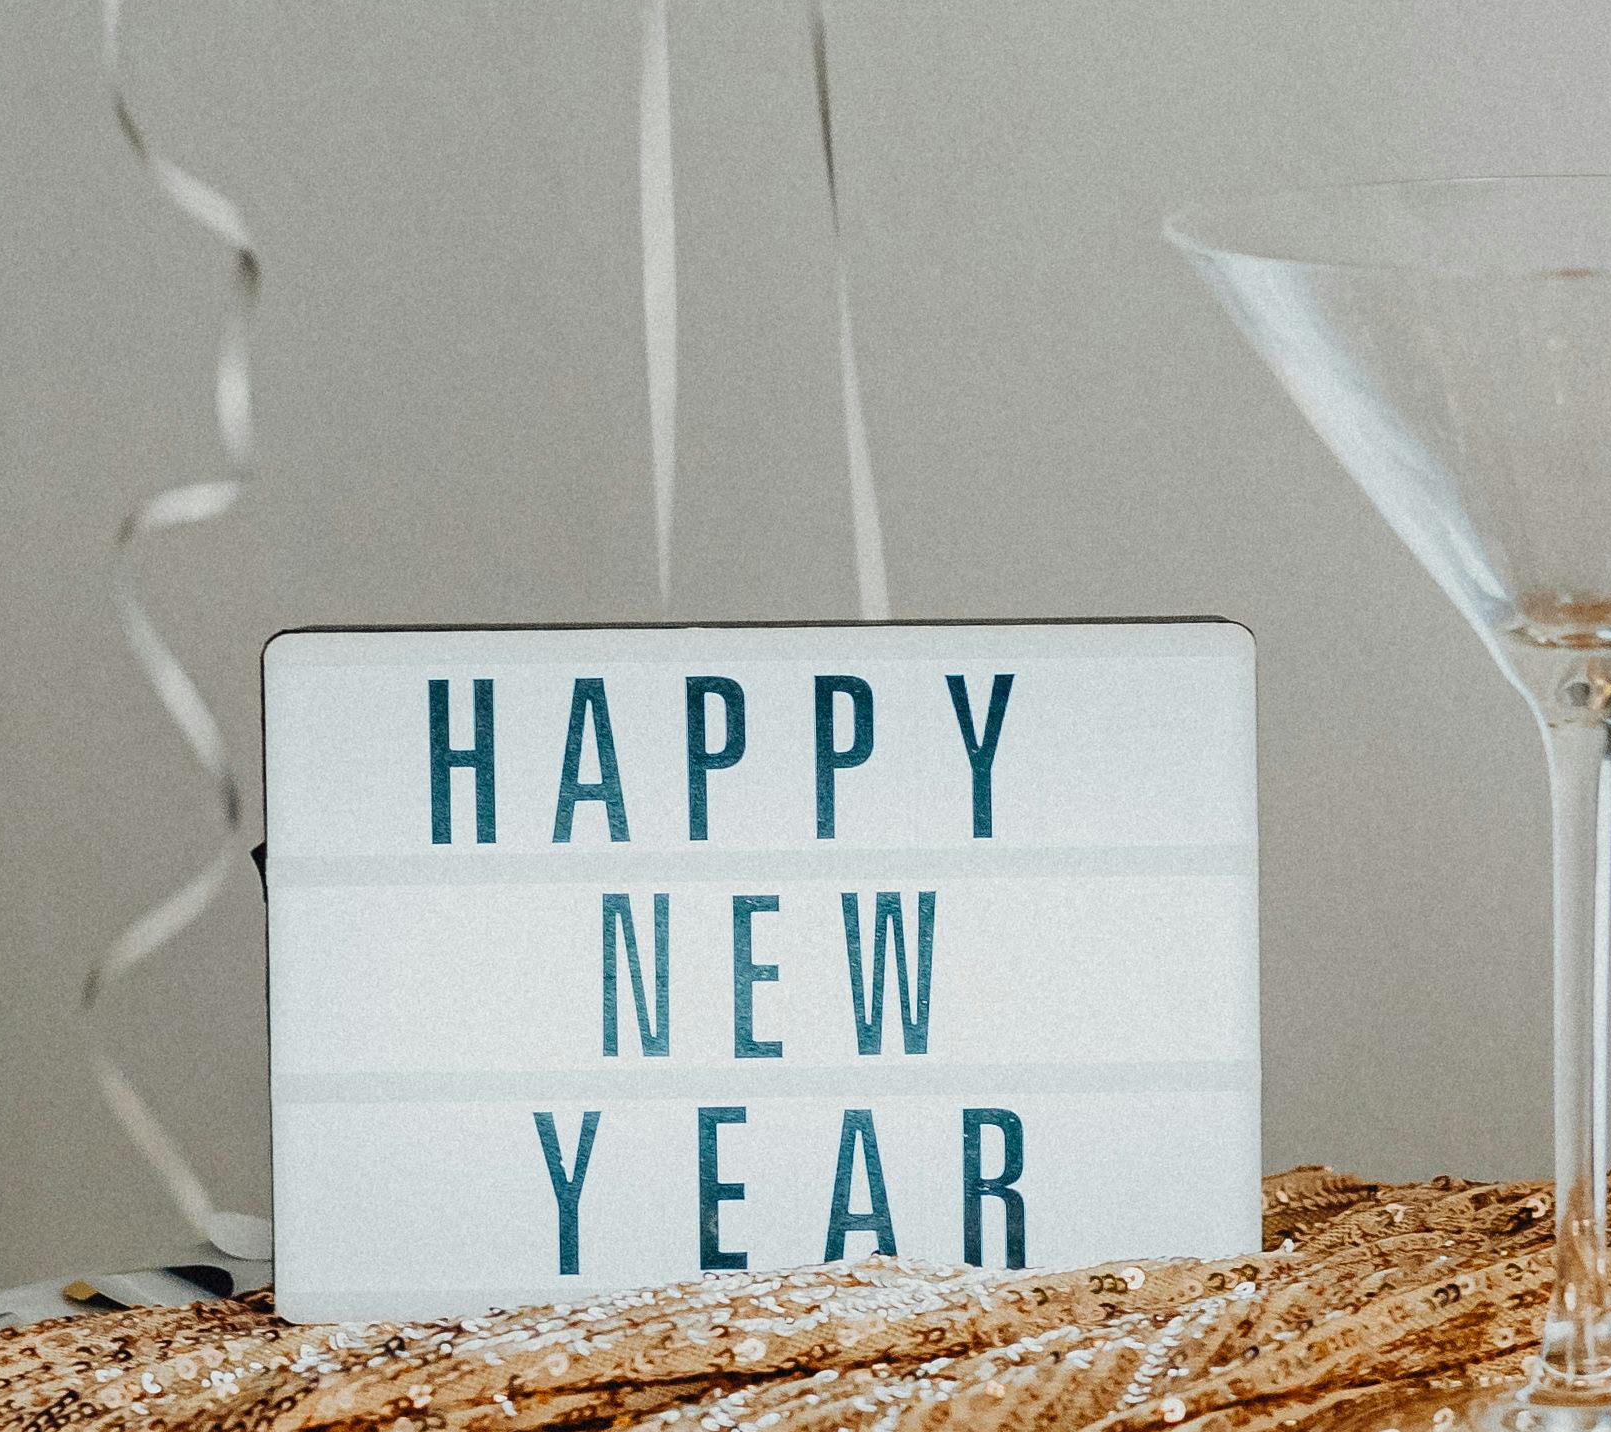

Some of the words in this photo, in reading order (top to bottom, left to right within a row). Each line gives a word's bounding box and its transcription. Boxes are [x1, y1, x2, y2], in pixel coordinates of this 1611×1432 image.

[427, 672, 1017, 846] HAPPY
[601, 889, 938, 1060] NEW
[531, 1105, 1029, 1277] YEAR
